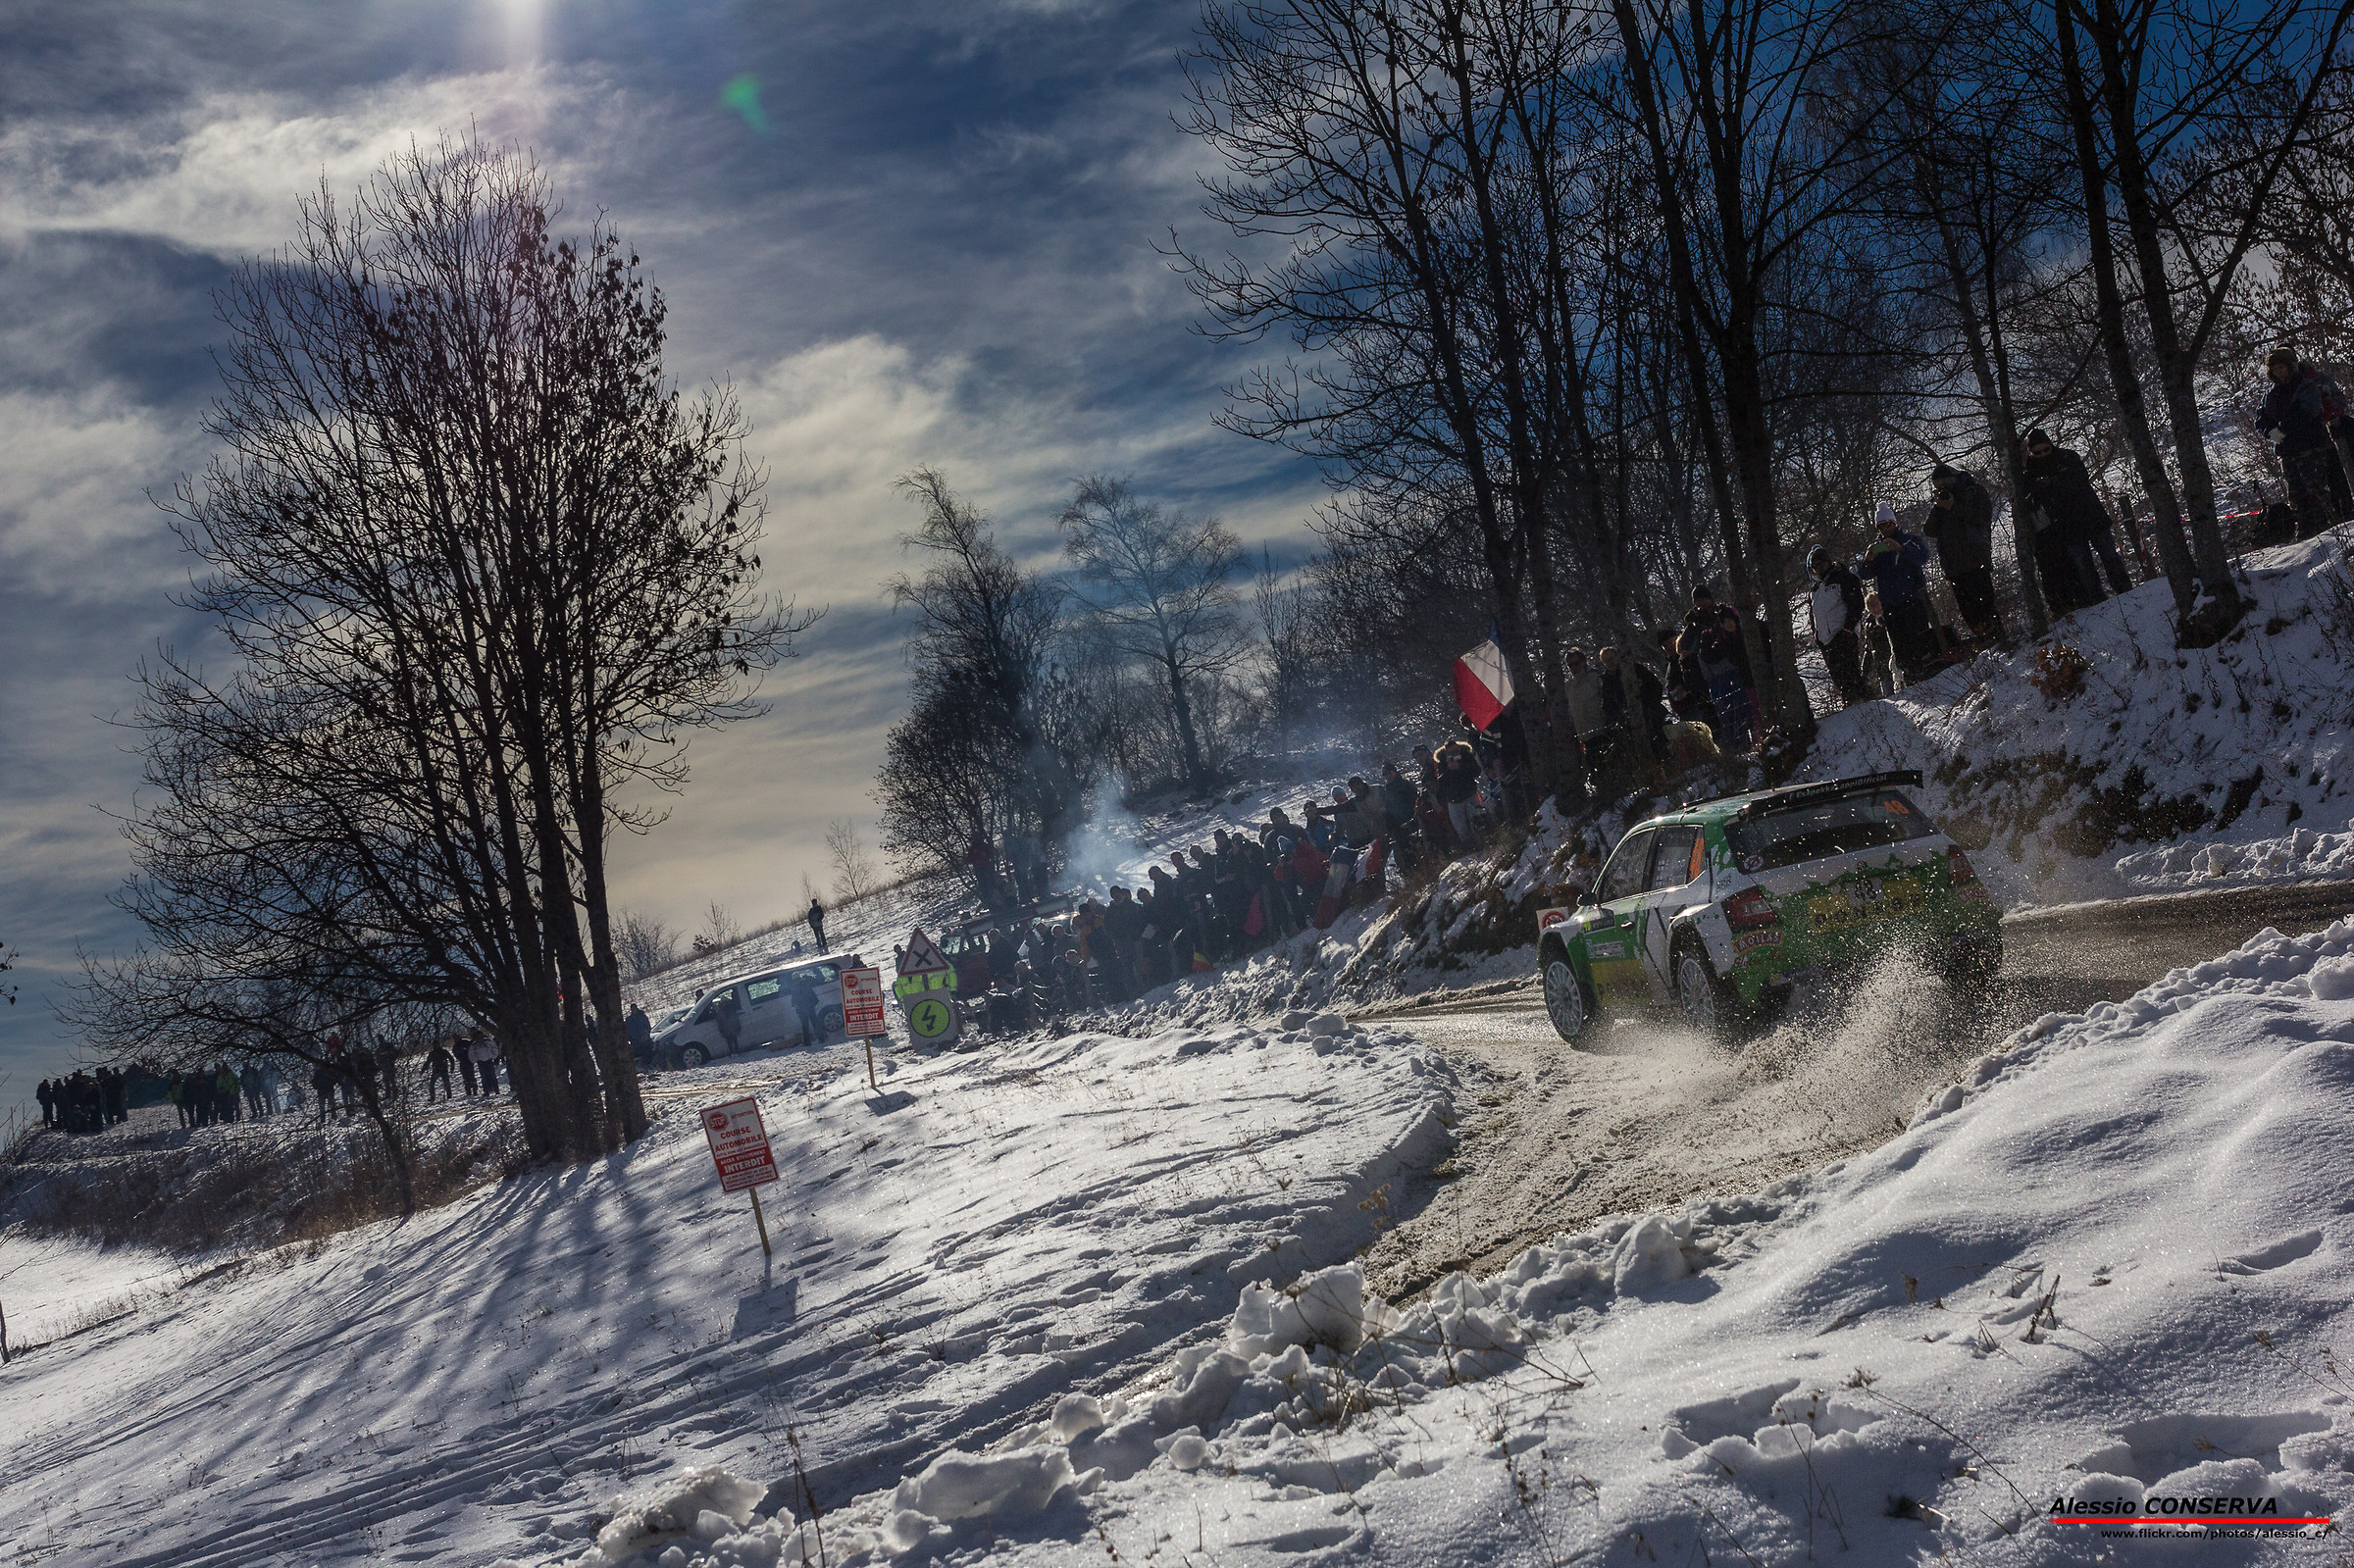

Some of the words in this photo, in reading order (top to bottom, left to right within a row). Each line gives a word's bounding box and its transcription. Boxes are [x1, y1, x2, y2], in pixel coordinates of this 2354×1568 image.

[1883, 799, 1910, 815] 48
[845, 995, 880, 1004] AUTOMOBILE
[710, 1116, 726, 1128] STOP
[720, 1126, 751, 1139] COURSE
[715, 1134, 764, 1152] AUTOMOBILE
[724, 1156, 765, 1174] INTERDIT
